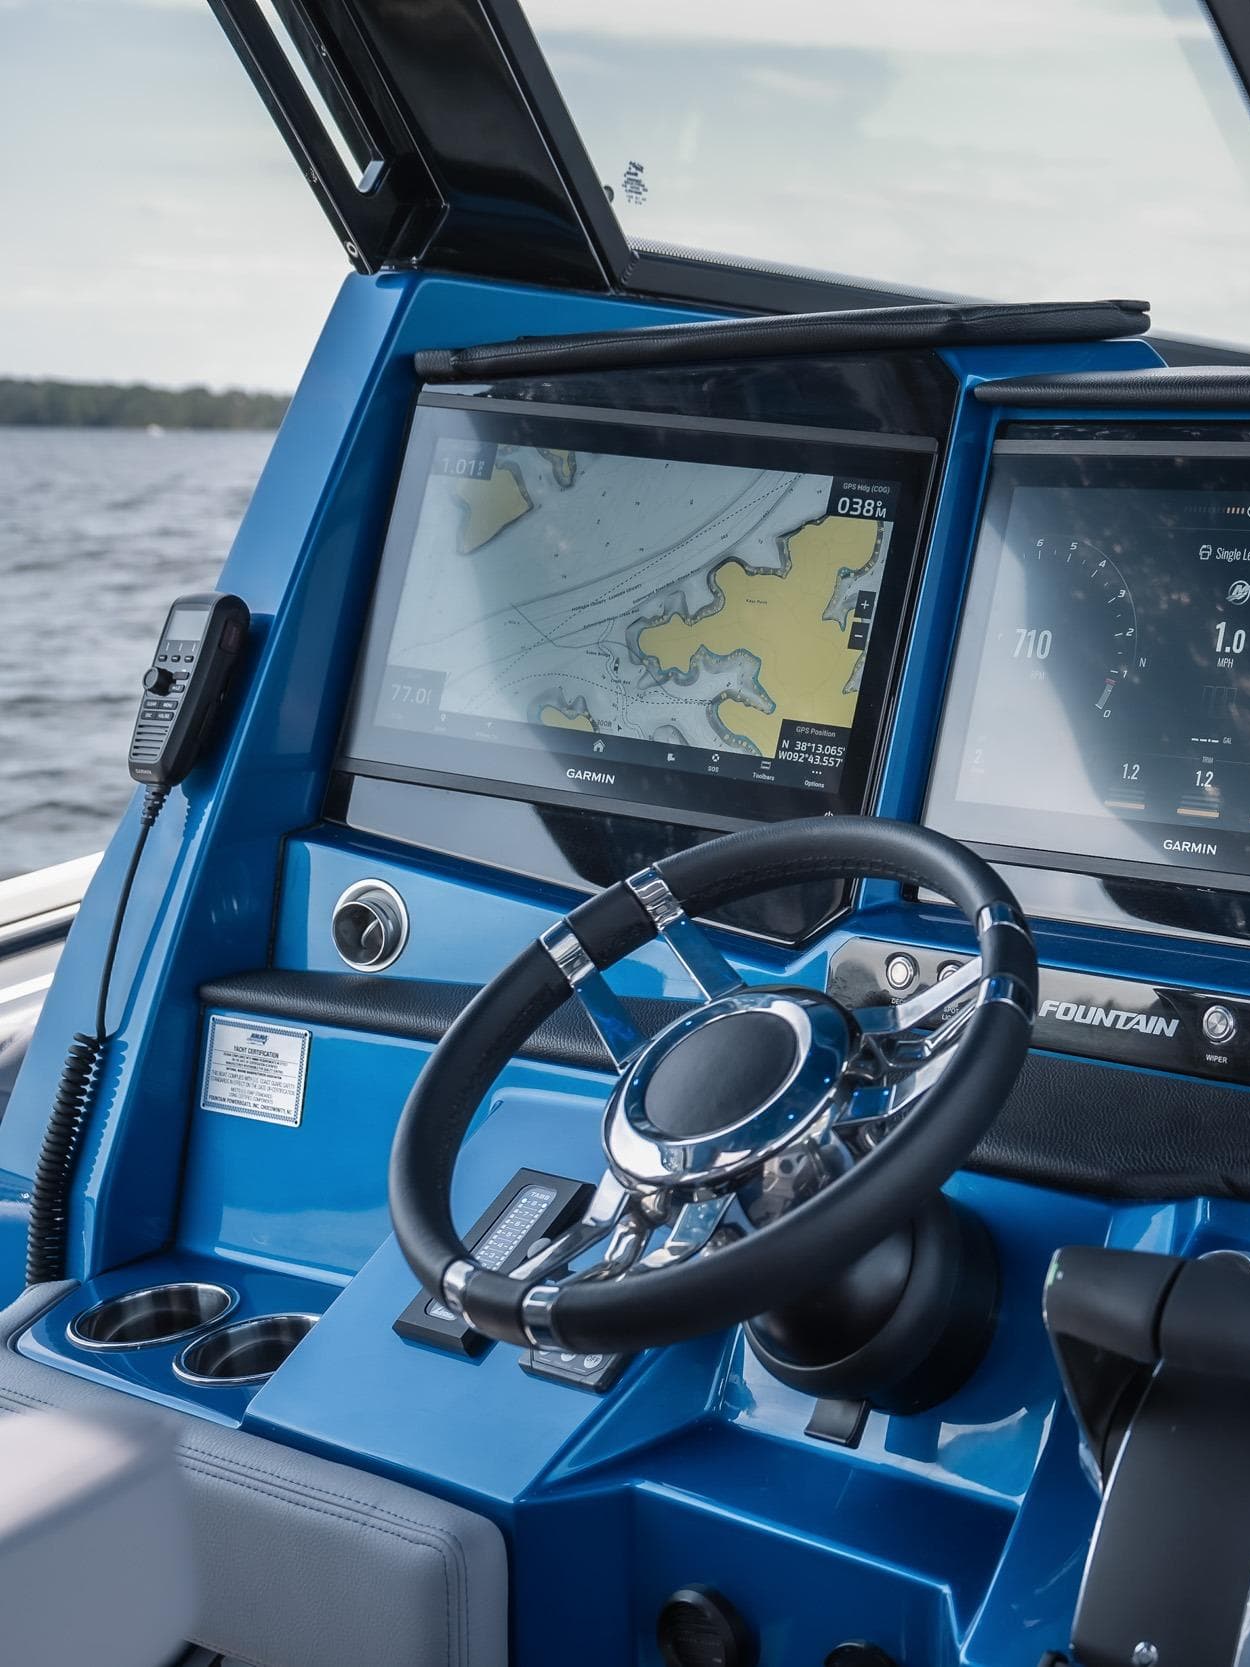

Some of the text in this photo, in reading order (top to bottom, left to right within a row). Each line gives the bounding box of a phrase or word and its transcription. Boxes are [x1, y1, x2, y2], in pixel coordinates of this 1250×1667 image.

[843, 482, 890, 494] GPS Hdg (COG)
[1036, 539, 1044, 547] 6
[1070, 542, 1078, 550] 5
[1216, 547, 1241, 563] Single
[1098, 559, 1107, 568] 4
[1118, 589, 1126, 598] 3
[1126, 628, 1135, 637] 2
[1215, 621, 1246, 654] 1.0
[1013, 628, 1053, 660] 710
[1139, 658, 1147, 668] N
[1216, 657, 1234, 669] MPH
[1122, 670, 1128, 678] 1
[1103, 709, 1111, 718] 0
[796, 726, 836, 737] GPS Position
[781, 740, 789, 749] N
[707, 765, 719, 773] SOS
[1122, 763, 1140, 780] 1.2
[566, 768, 615, 785] GARMIN
[753, 772, 775, 781] Toolbars
[1195, 770, 1214, 788] 1.2
[804, 779, 825, 789] Options
[1163, 839, 1217, 856] GARMIN
[943, 1006, 959, 1014] SPOT
[1038, 999, 1180, 1037] FOUNTAIN
[247, 1048, 279, 1057] CERTIFICATION
[1205, 1053, 1228, 1064] WIPER
